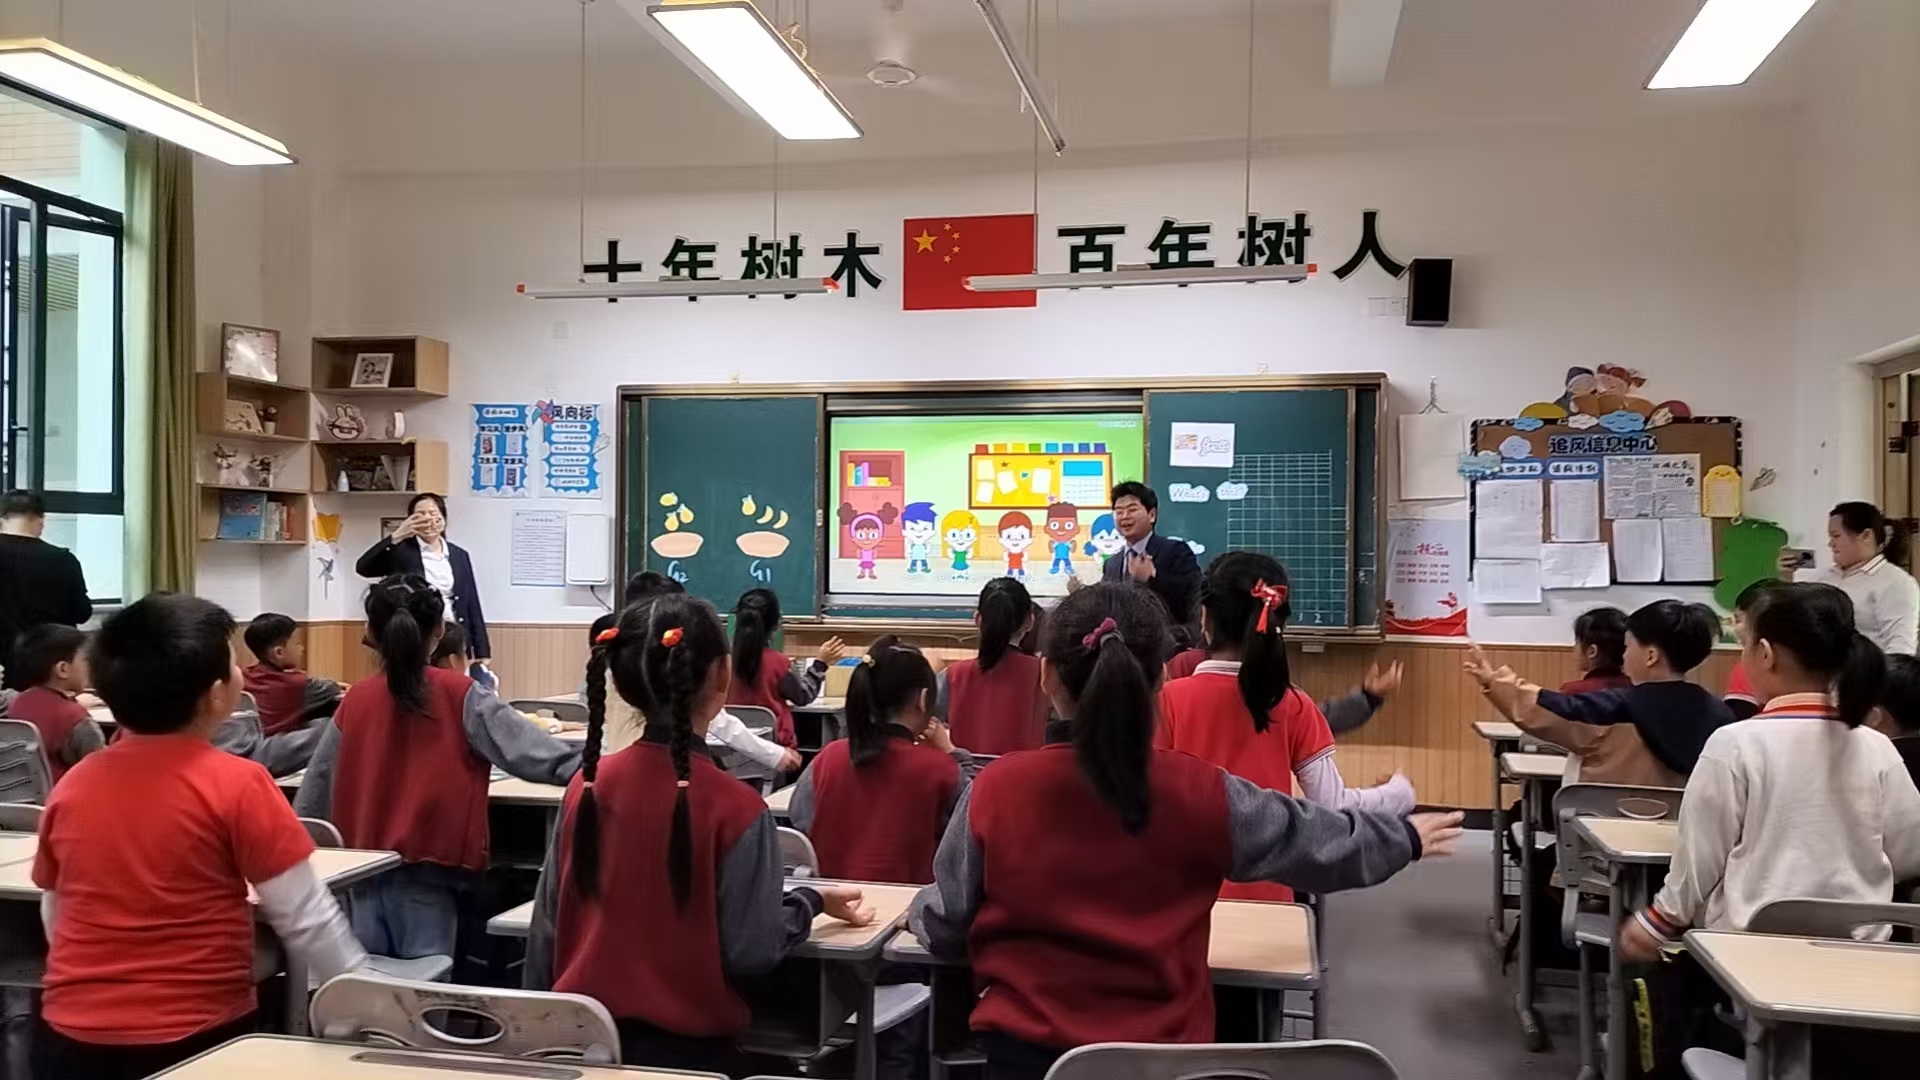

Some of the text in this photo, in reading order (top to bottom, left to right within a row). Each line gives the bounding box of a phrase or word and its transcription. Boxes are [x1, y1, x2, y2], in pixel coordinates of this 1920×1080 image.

[582, 209, 1408, 303] 十年树木 百年树人
[1549, 435, 1659, 454] 追风信息中心
